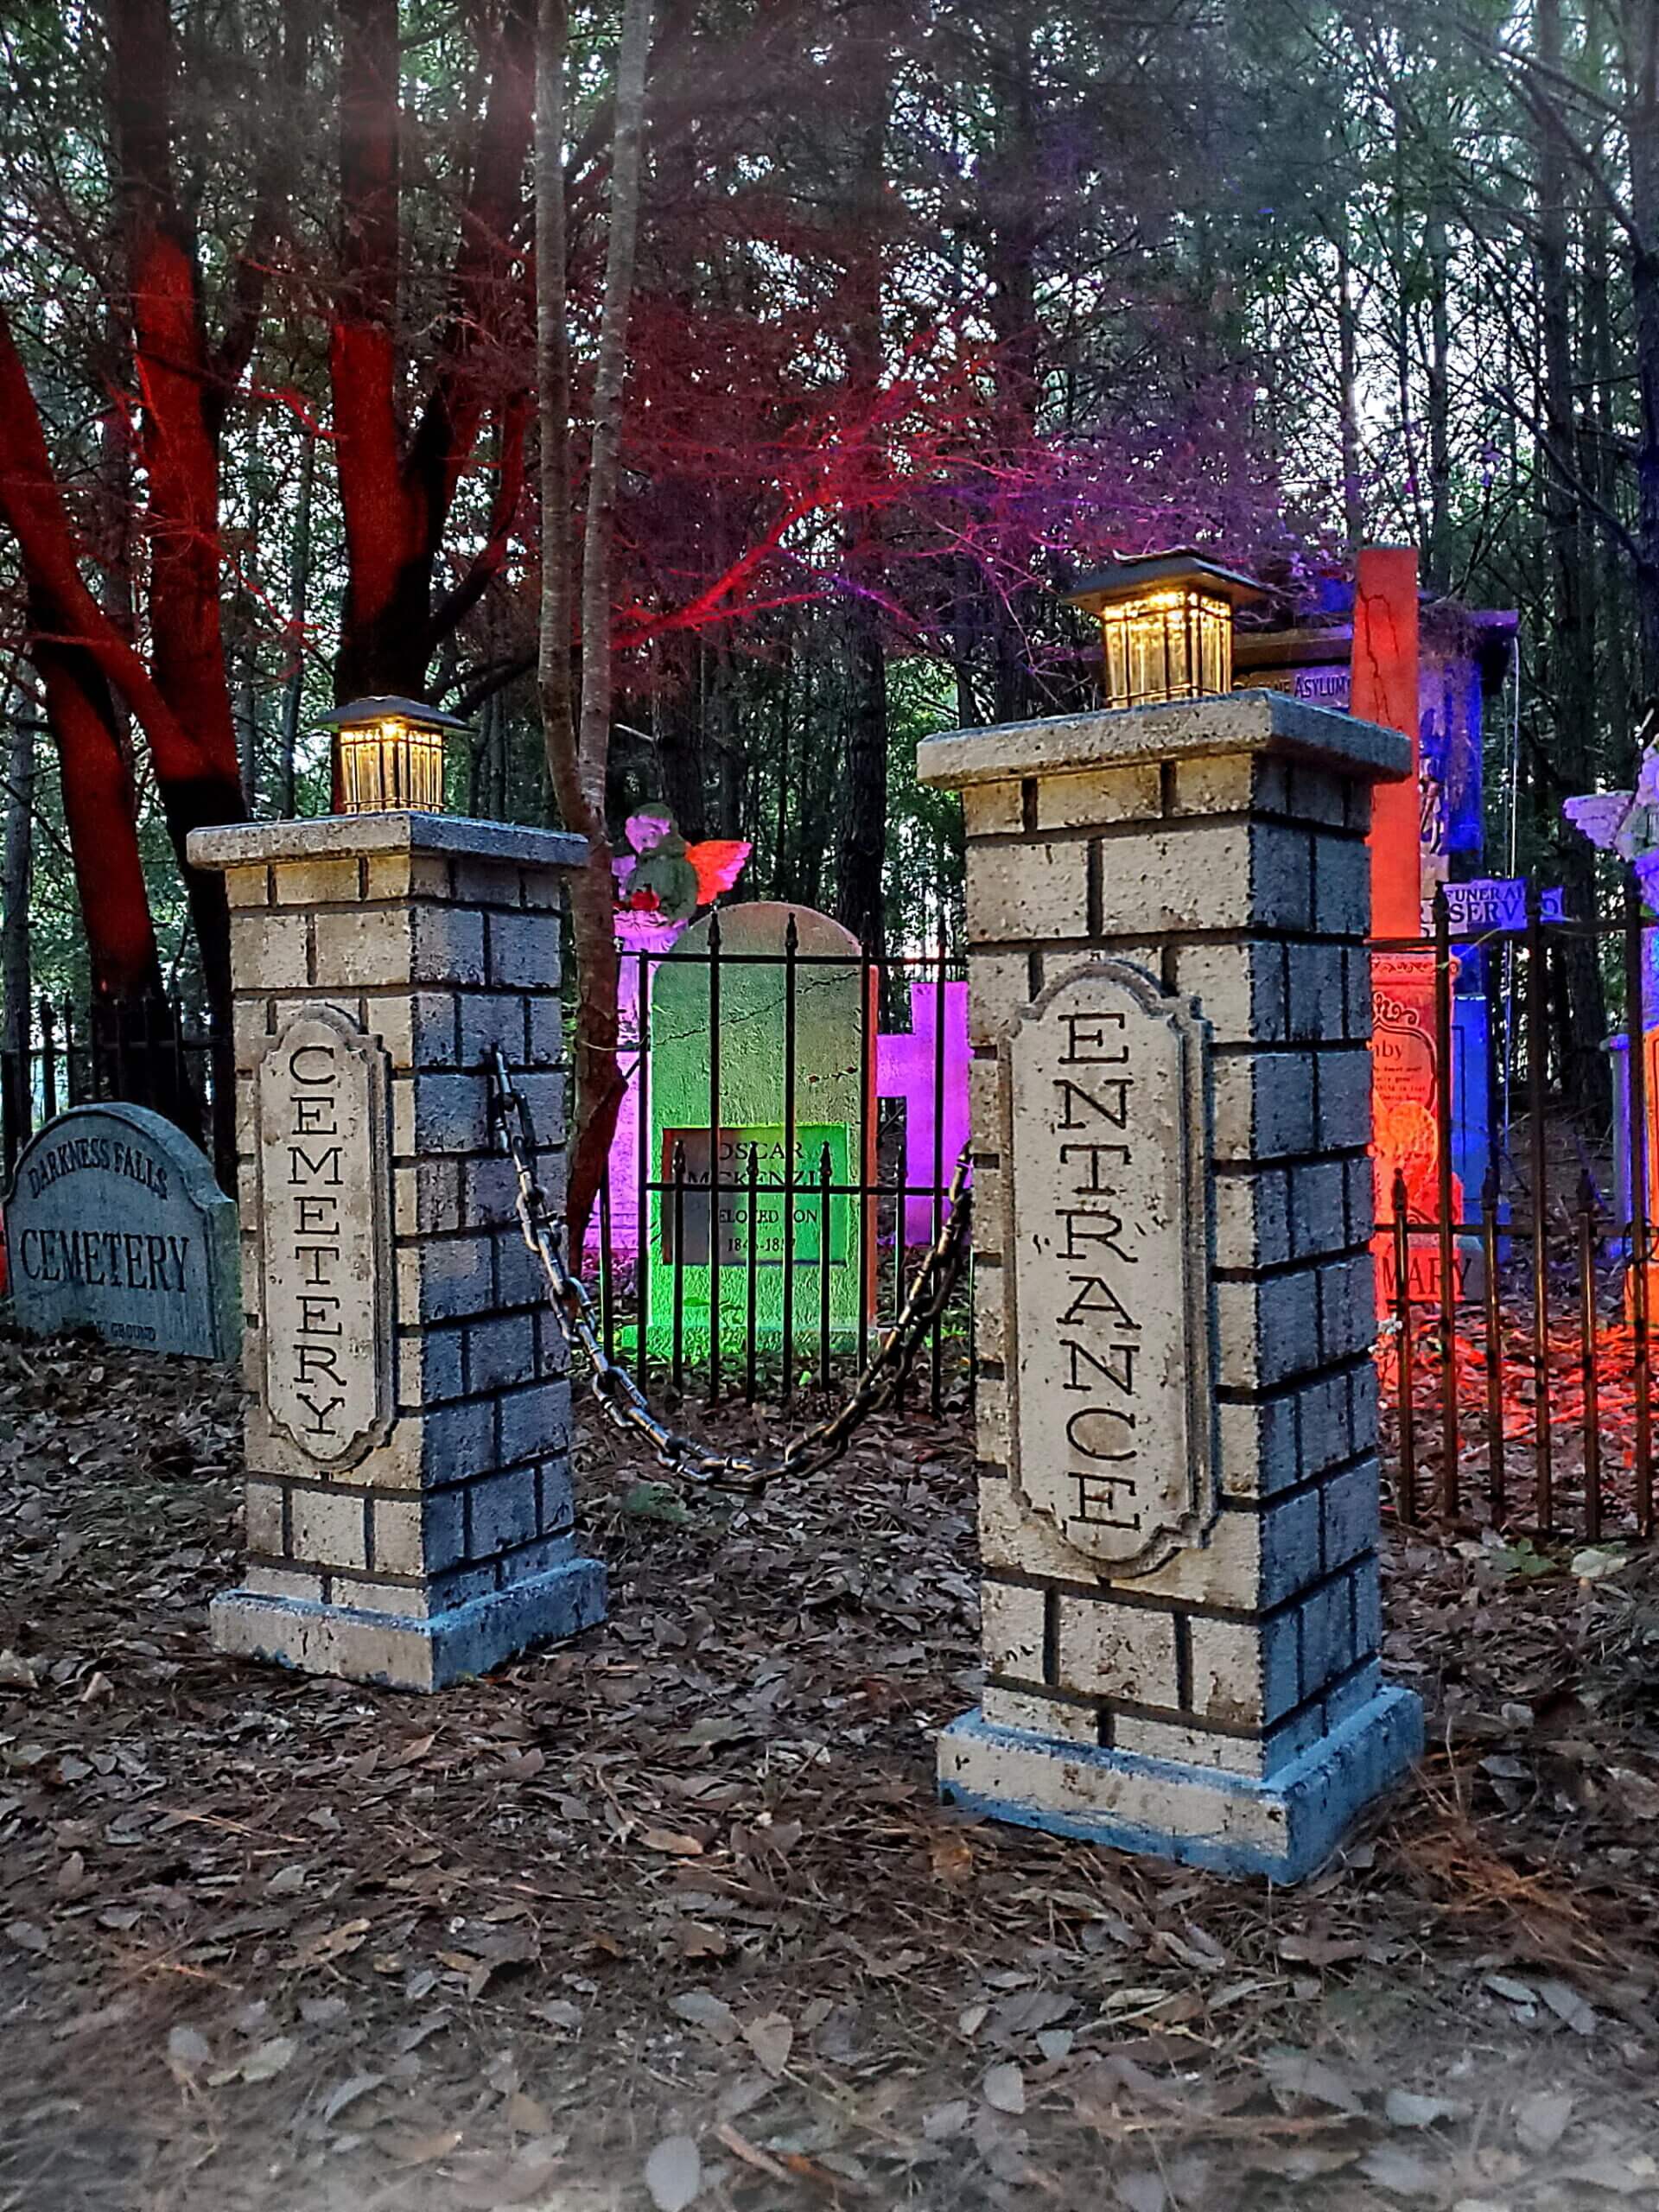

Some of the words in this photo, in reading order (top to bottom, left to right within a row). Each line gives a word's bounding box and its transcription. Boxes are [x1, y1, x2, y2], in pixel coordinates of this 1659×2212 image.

[20, 1228, 190, 1293] CEMETERY
[28, 1137, 110, 1199] DARKNESS
[113, 1141, 168, 1200] FALLS
[287, 1045, 346, 1436] CEMETERY
[1052, 1012, 1142, 1532] ENTRANCE
